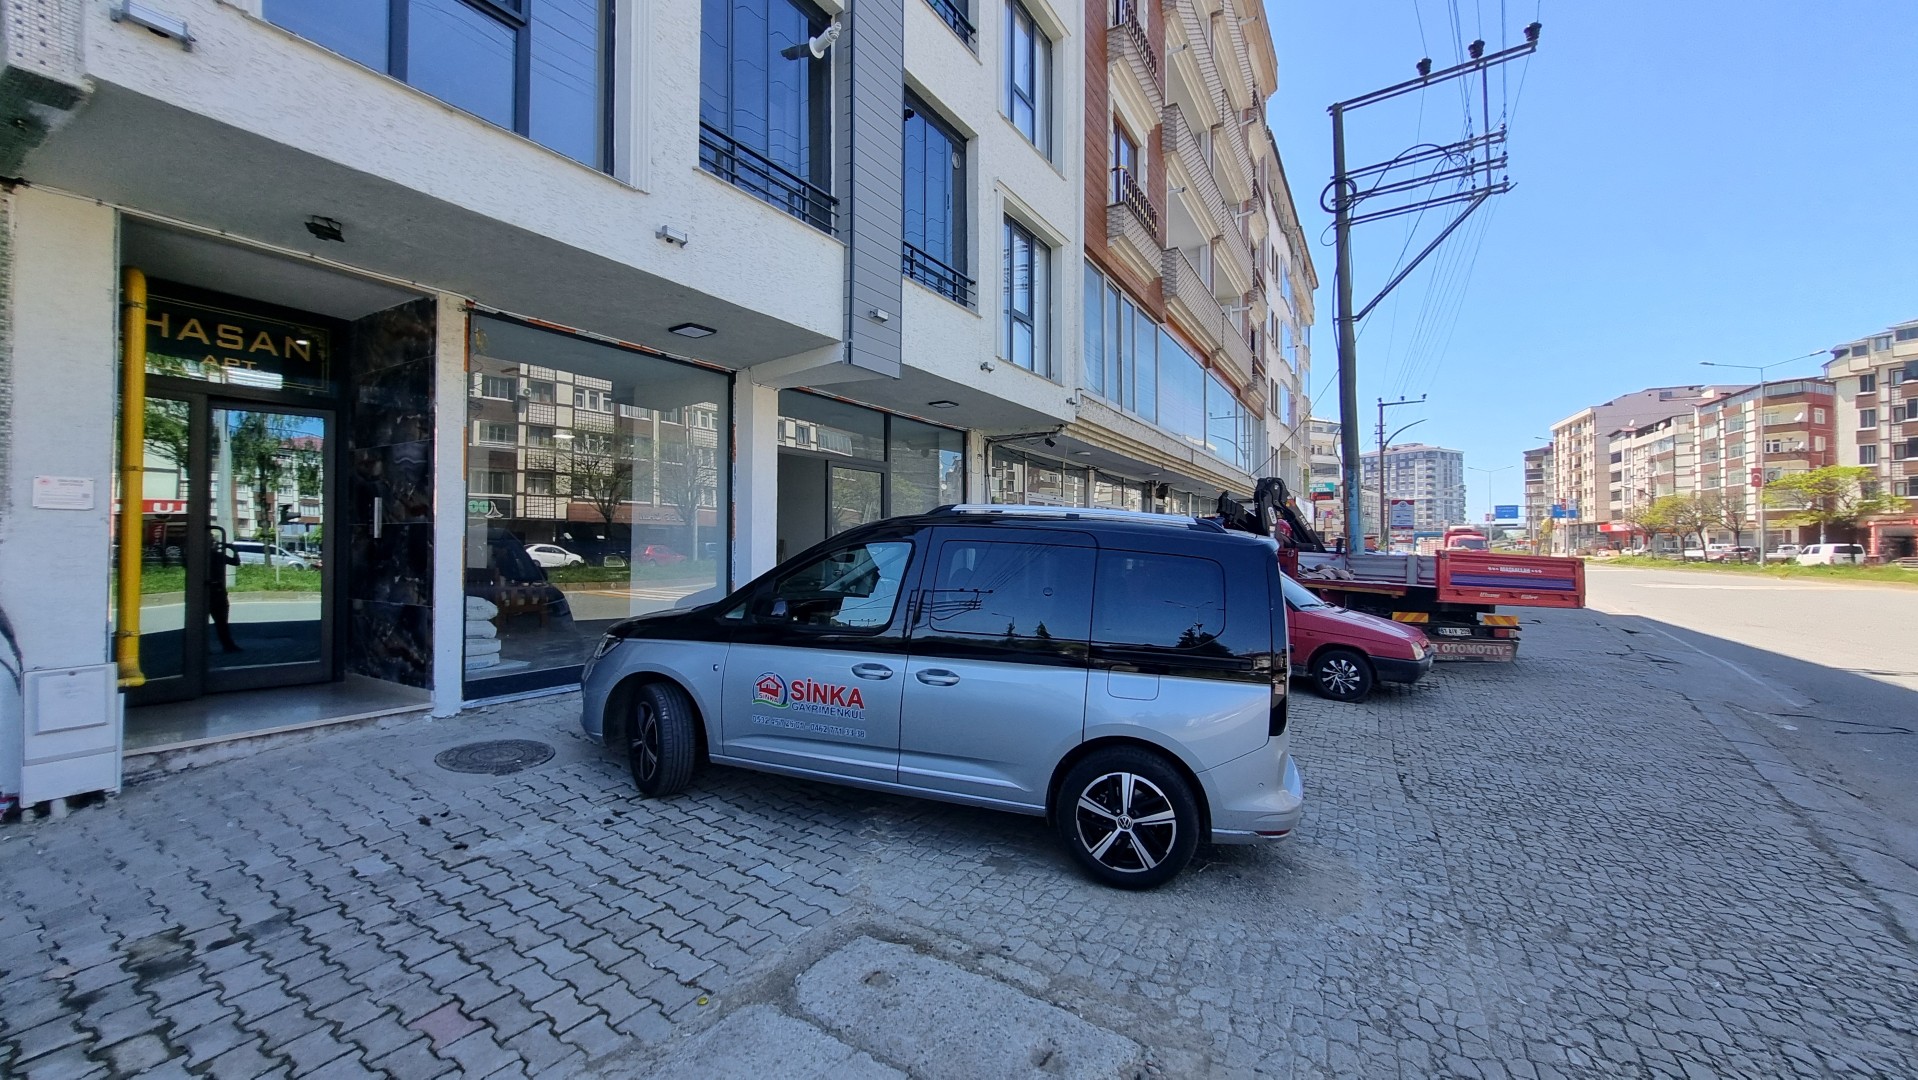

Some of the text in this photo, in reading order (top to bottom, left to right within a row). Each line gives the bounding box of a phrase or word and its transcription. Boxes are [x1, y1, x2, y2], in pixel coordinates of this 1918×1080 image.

[146, 312, 311, 362] HASAN
[790, 678, 865, 709] SİNKA
[791, 702, 865, 720] GAYRİMENKUL
[810, 723, 828, 734] 0462
